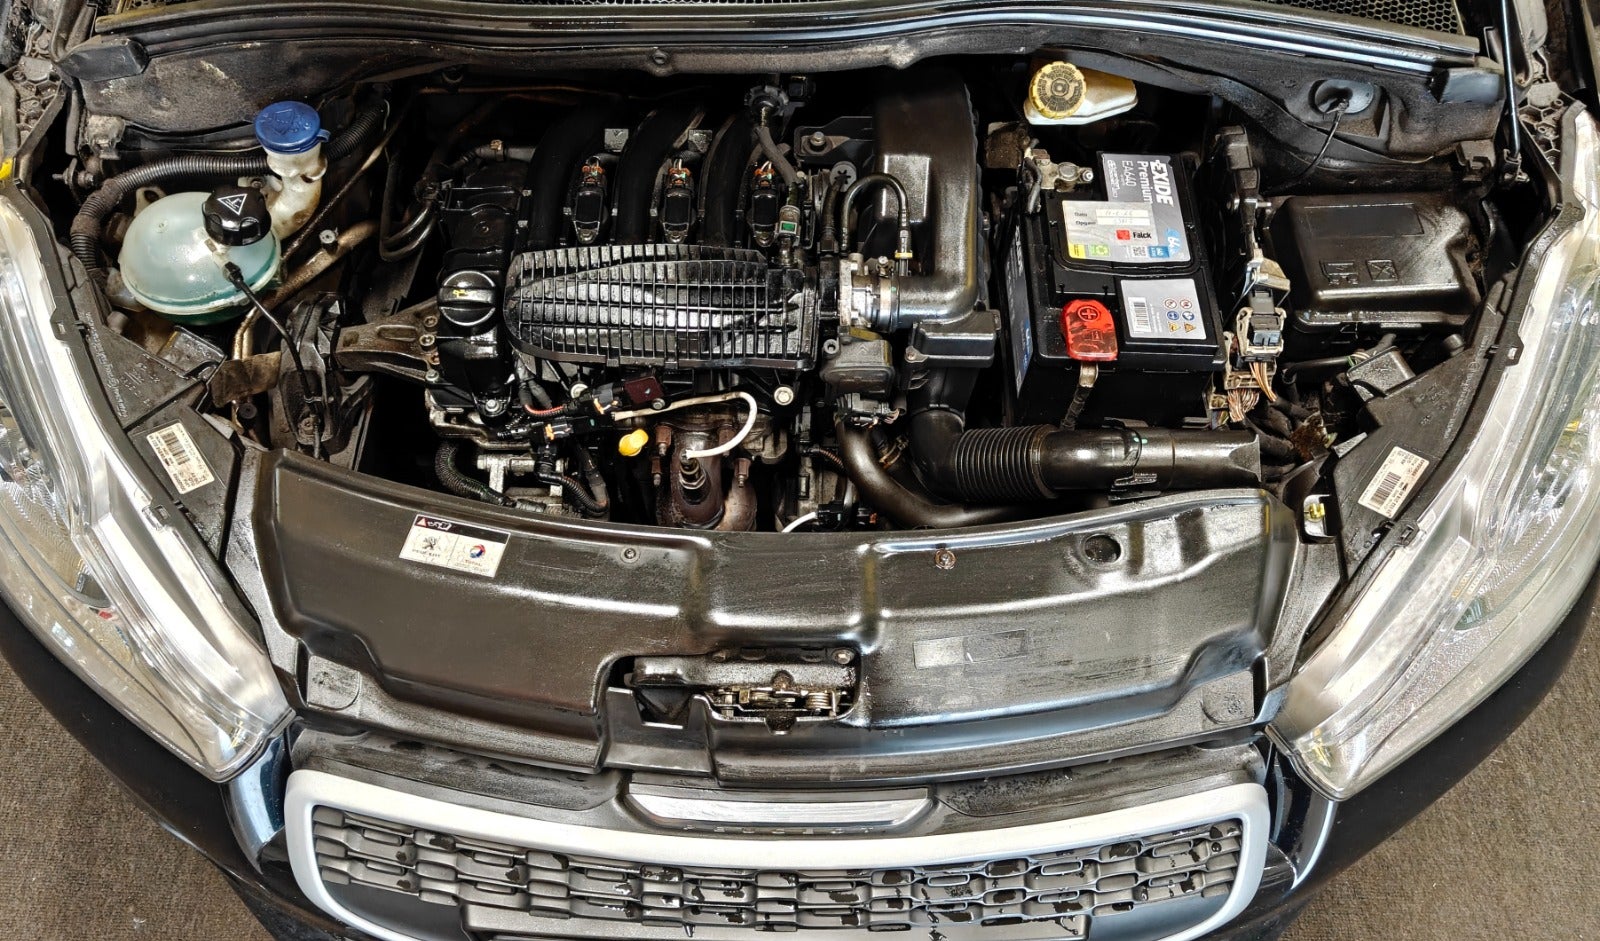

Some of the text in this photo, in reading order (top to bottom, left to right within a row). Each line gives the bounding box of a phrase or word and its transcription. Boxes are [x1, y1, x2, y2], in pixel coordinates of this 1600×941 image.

[1121, 160, 1137, 187] EA640
[1137, 160, 1153, 204] Premium
[1150, 159, 1174, 207] EXIDE
[1132, 231, 1152, 240] Falck
